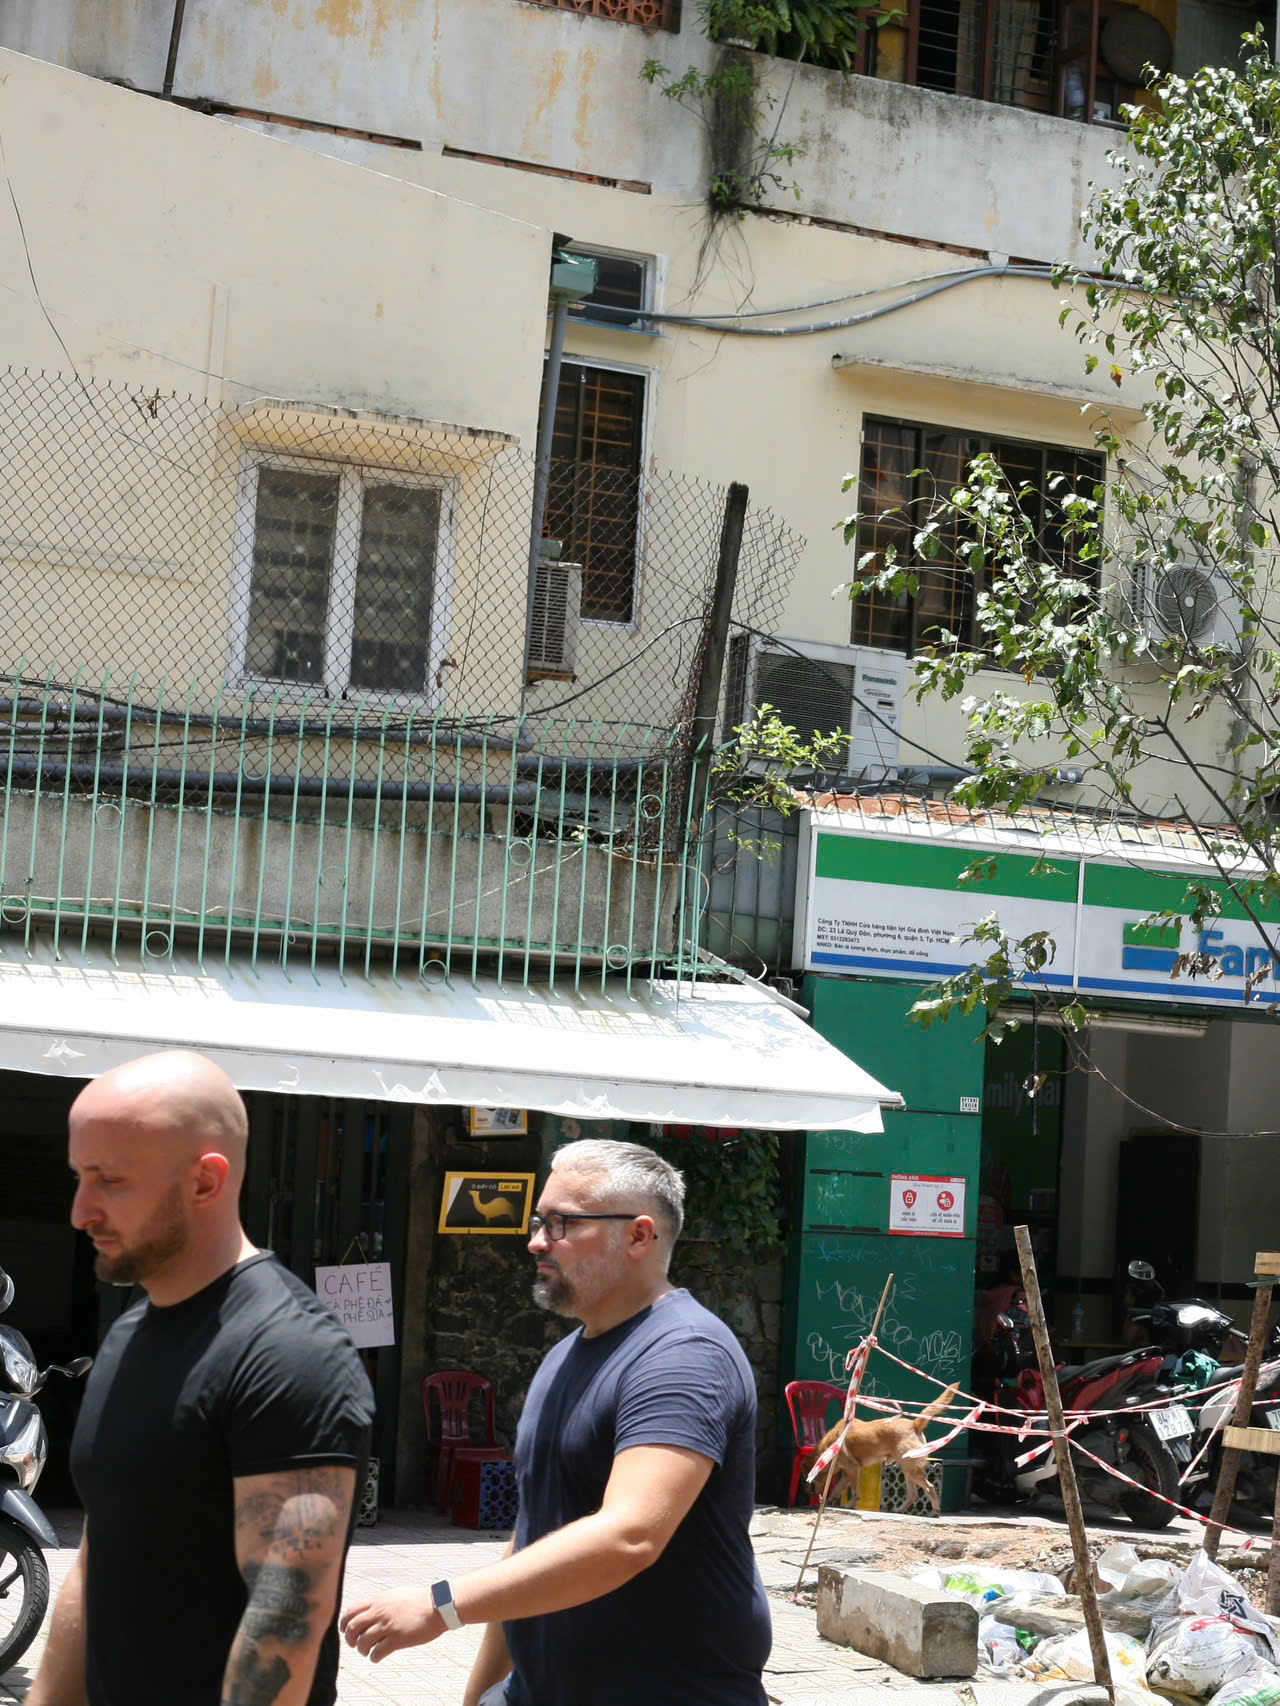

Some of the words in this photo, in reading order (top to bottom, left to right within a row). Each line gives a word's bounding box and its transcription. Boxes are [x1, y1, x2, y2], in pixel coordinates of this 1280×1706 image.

[862, 674, 897, 686] Panasonic
[829, 926, 837, 934] 23
[837, 927, 845, 935] Lê
[936, 936, 950, 945] HCM
[834, 919, 841, 928] Ty
[842, 920, 858, 928] TNHH
[907, 925, 917, 934] Gia
[930, 927, 942, 936] Việt
[942, 929, 956, 937] Nam
